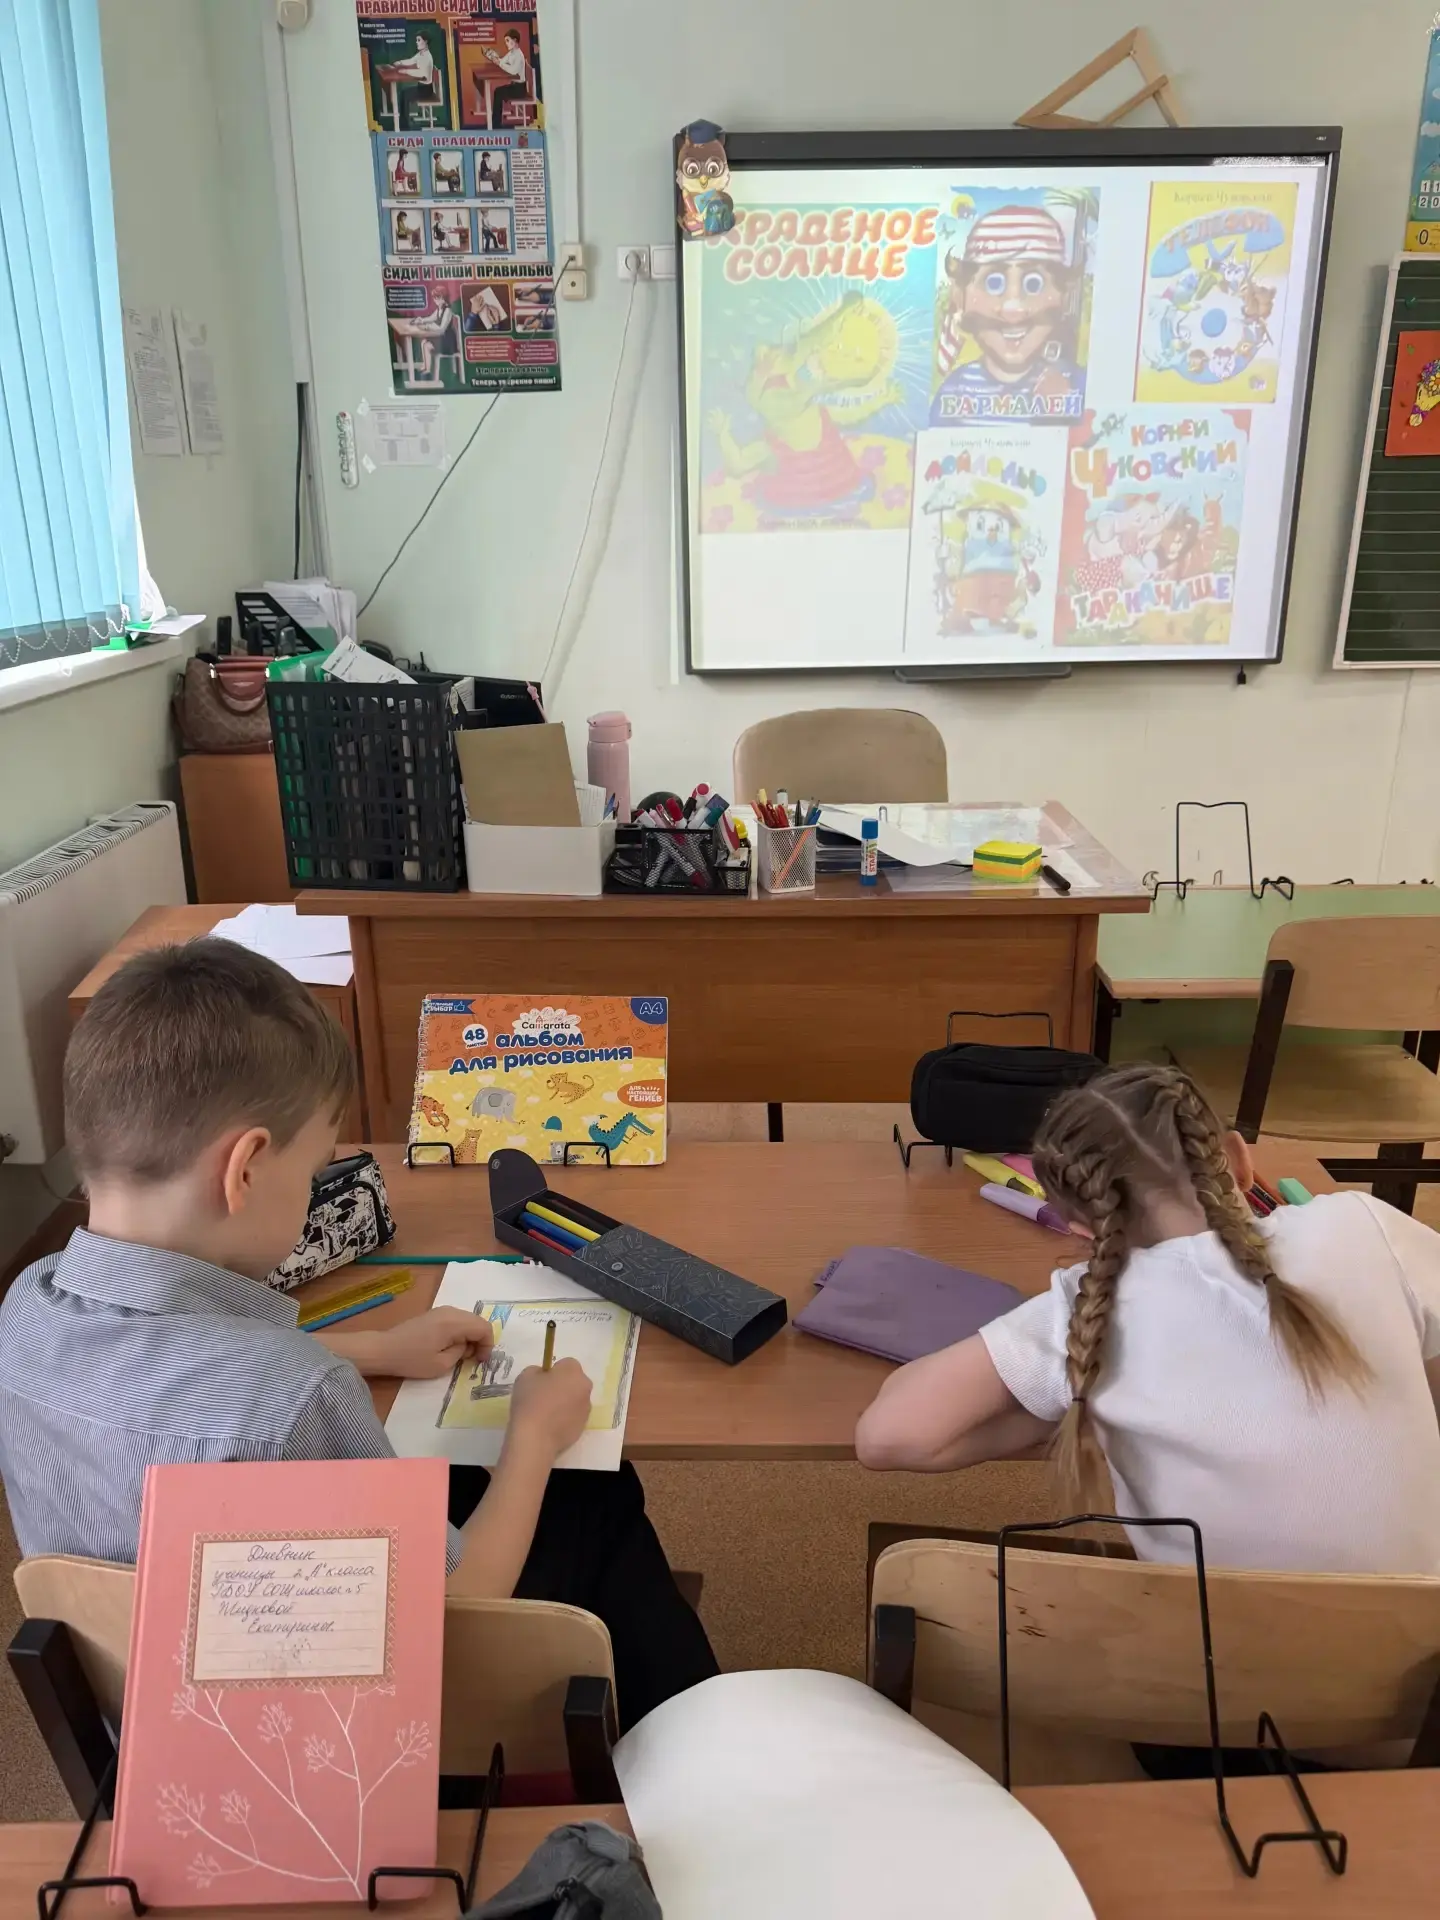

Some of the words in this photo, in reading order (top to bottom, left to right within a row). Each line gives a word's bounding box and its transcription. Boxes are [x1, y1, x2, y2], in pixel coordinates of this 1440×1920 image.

[356, 0, 435, 14] ПРАВИЛЬНО
[440, 0, 478, 14] СИДИ
[482, 0, 491, 13] И
[388, 137, 424, 147] СИДИ
[432, 136, 511, 146] ПРАВИЛЬНО
[383, 267, 419, 281] СИДИ
[423, 267, 431, 279] И
[435, 266, 473, 278] ПИШИ
[477, 264, 553, 277] ПРАВИЛЬНО
[725, 245, 909, 283] СОЛНЦЕ
[941, 390, 1084, 418] БАРМАЛЕЙ
[1072, 576, 1231, 628] ТАРАКАНИЩЕ
[465, 1029, 485, 1041] 48
[496, 1031, 583, 1047] альбом
[449, 1057, 497, 1075] для
[504, 1047, 633, 1072] рисования
[247, 1543, 316, 1561] Дневник
